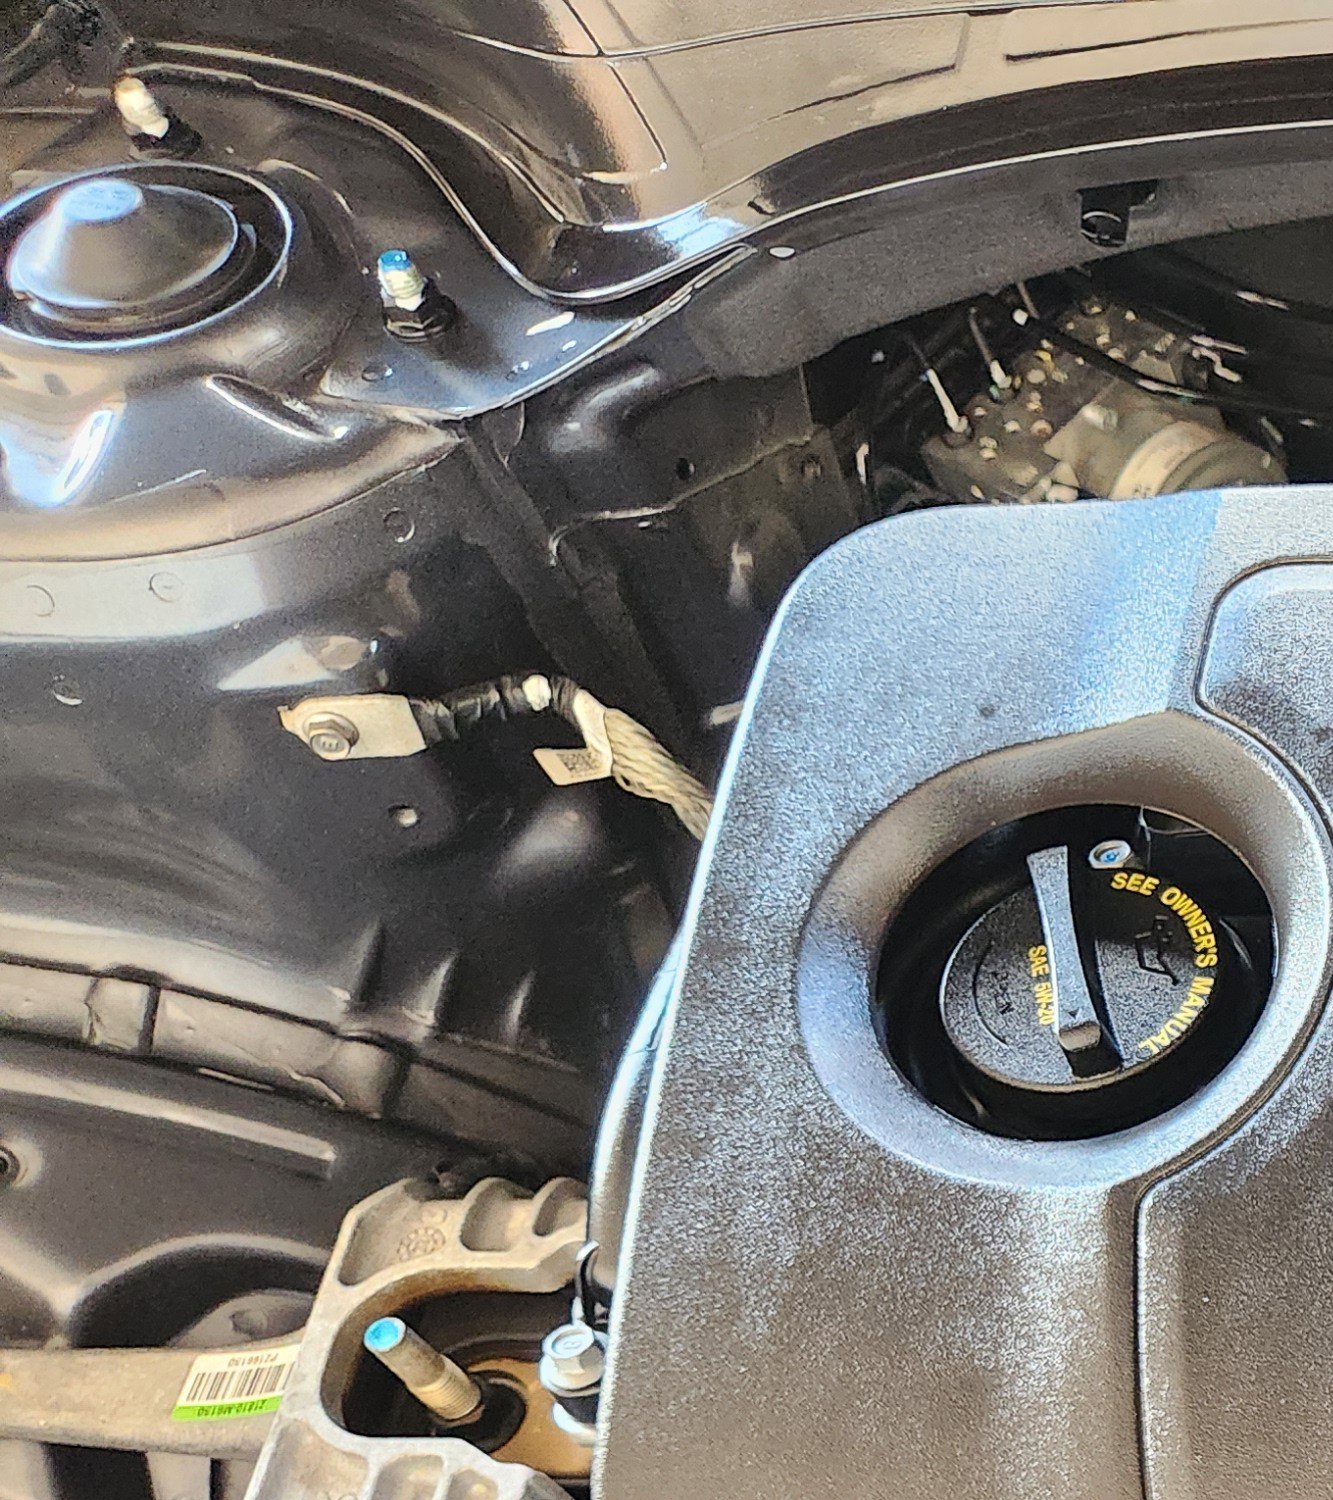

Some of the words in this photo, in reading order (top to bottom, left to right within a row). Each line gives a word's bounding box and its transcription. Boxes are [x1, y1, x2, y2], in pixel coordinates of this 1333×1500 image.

[1110, 872, 1161, 896] SEE
[1160, 886, 1219, 970] OWNER'S
[1027, 944, 1050, 978] SAE
[1138, 976, 1215, 1055] MANUAL
